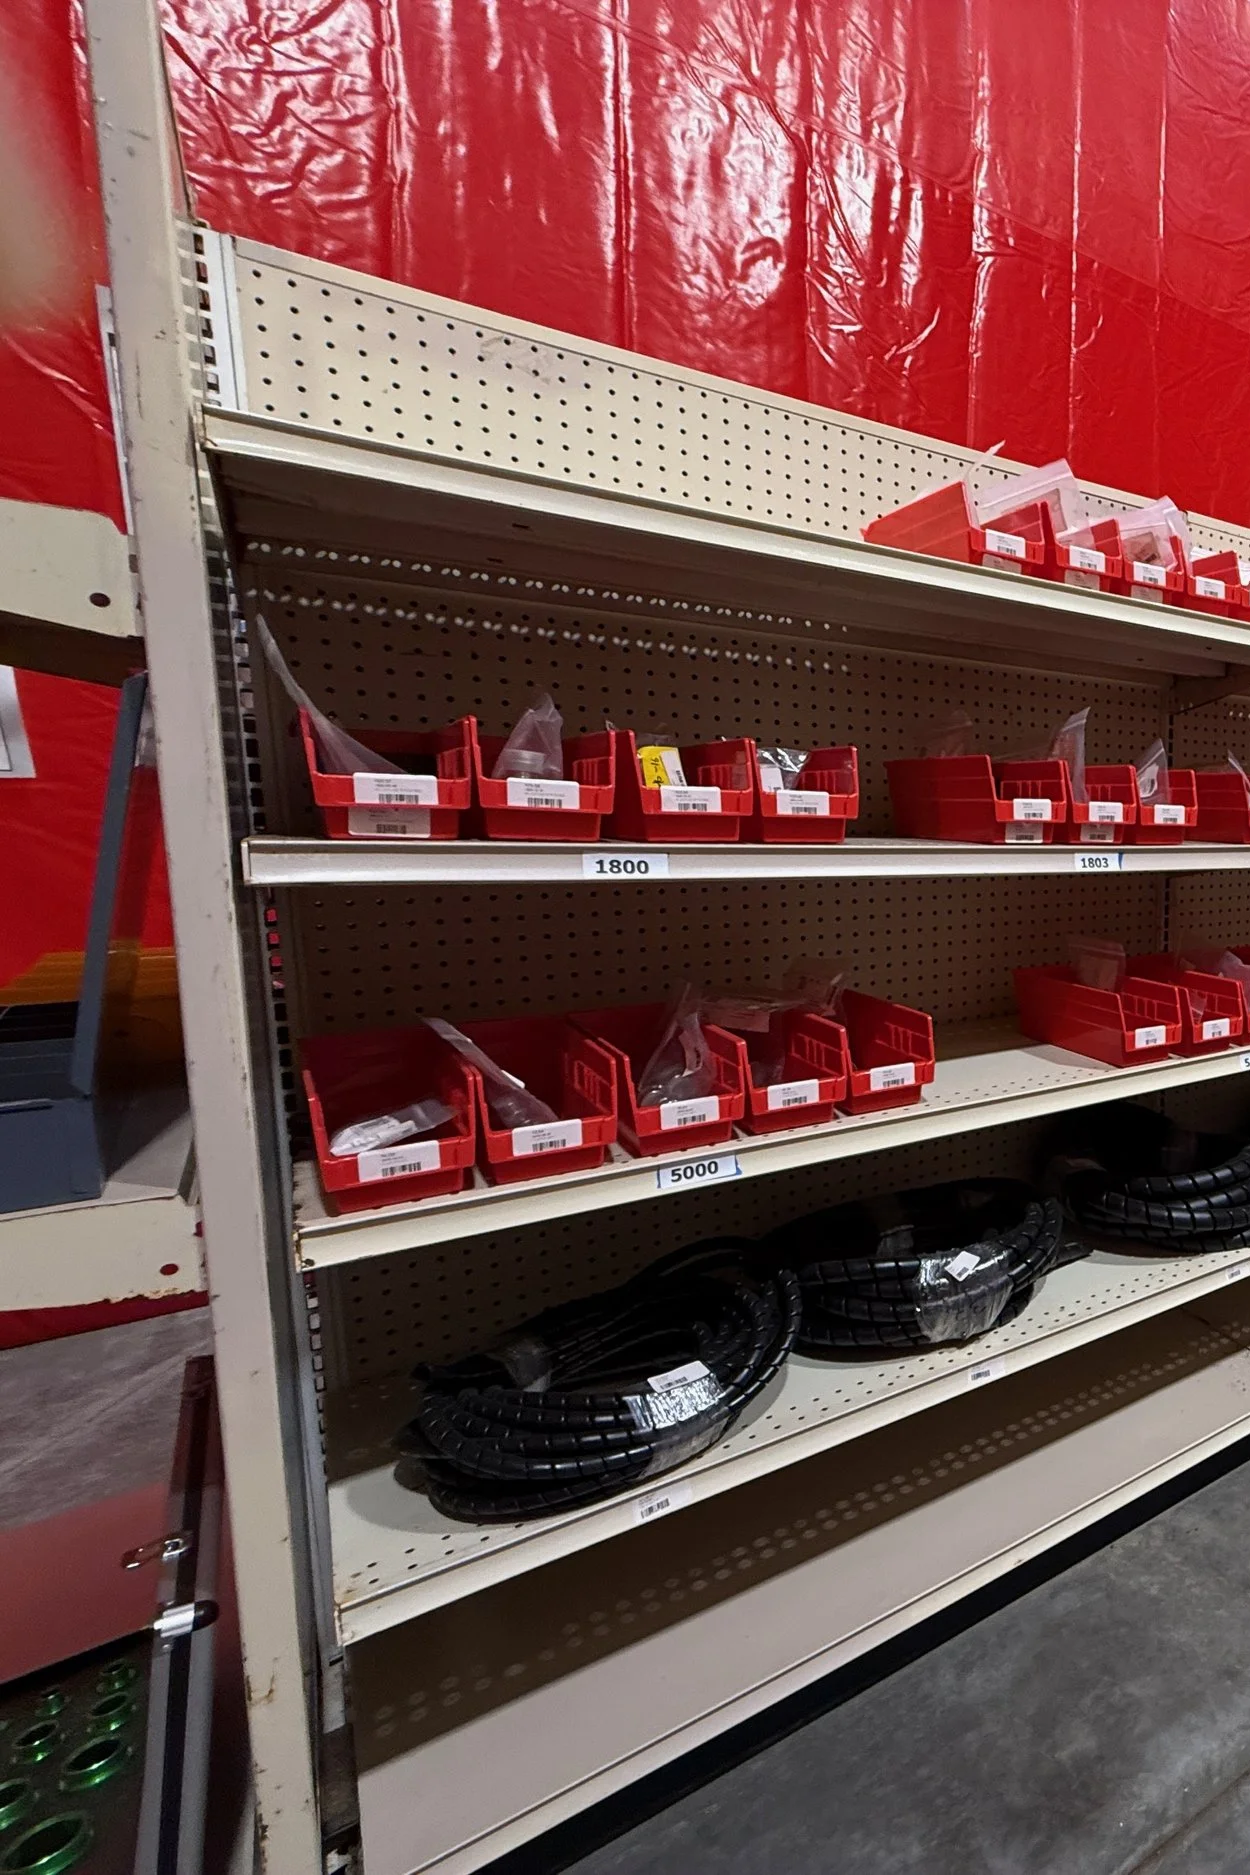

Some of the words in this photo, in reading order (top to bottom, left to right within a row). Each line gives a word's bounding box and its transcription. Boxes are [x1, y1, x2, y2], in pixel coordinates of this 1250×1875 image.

[595, 859, 649, 874] 1800
[1080, 857, 1109, 868] 1803
[670, 1160, 719, 1183] 5000
